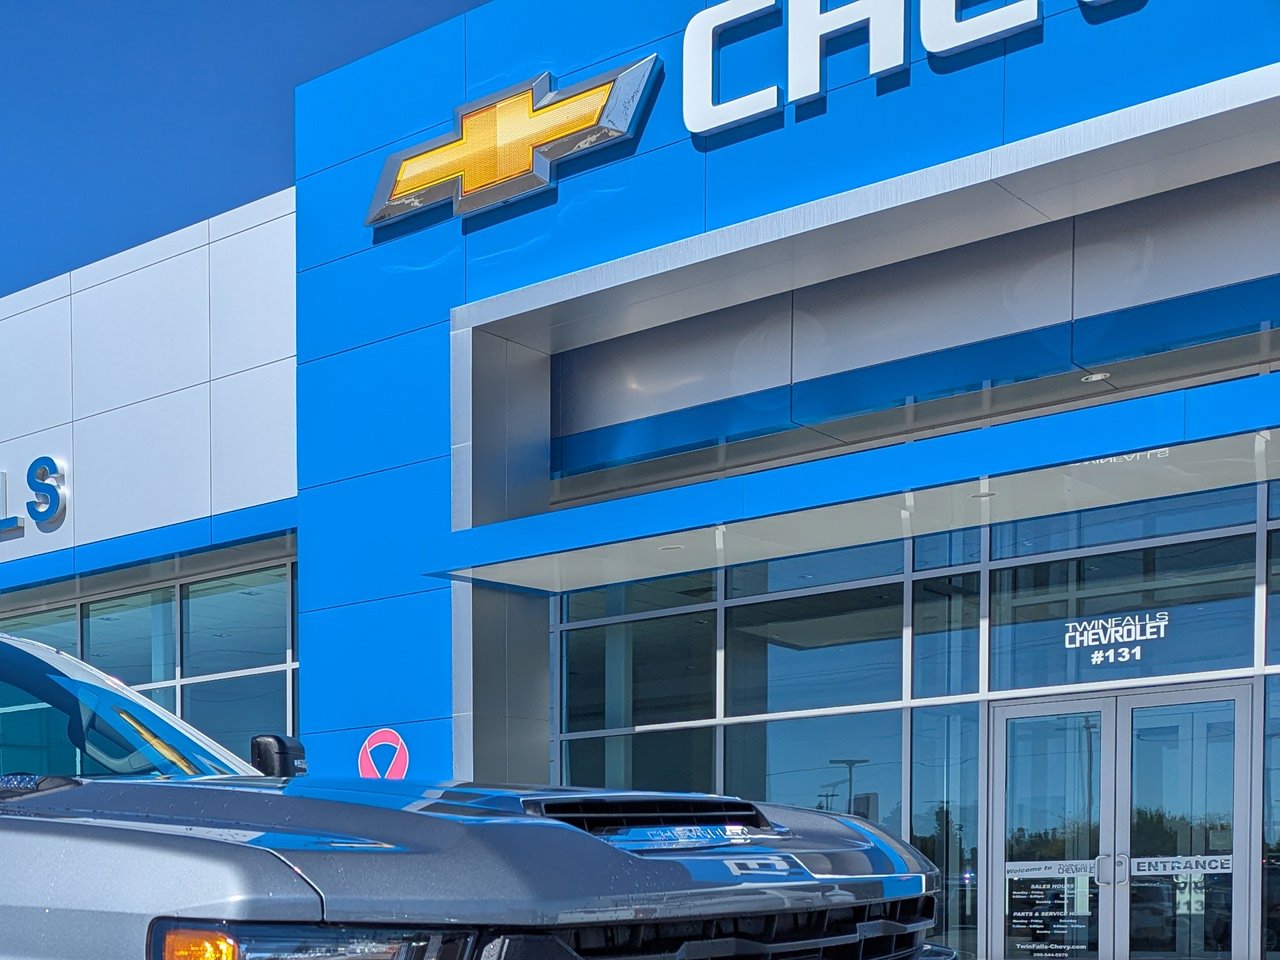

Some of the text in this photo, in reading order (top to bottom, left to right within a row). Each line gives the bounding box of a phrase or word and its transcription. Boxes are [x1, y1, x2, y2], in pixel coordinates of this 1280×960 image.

[683, 0, 1117, 136] CH
[1065, 611, 1169, 632] TWINFALLS
[1065, 621, 1169, 648] CHEVROLET
[1091, 645, 1141, 665] #131
[1006, 866, 1042, 875] Welcome
[1136, 859, 1231, 872] ENTRANCE
